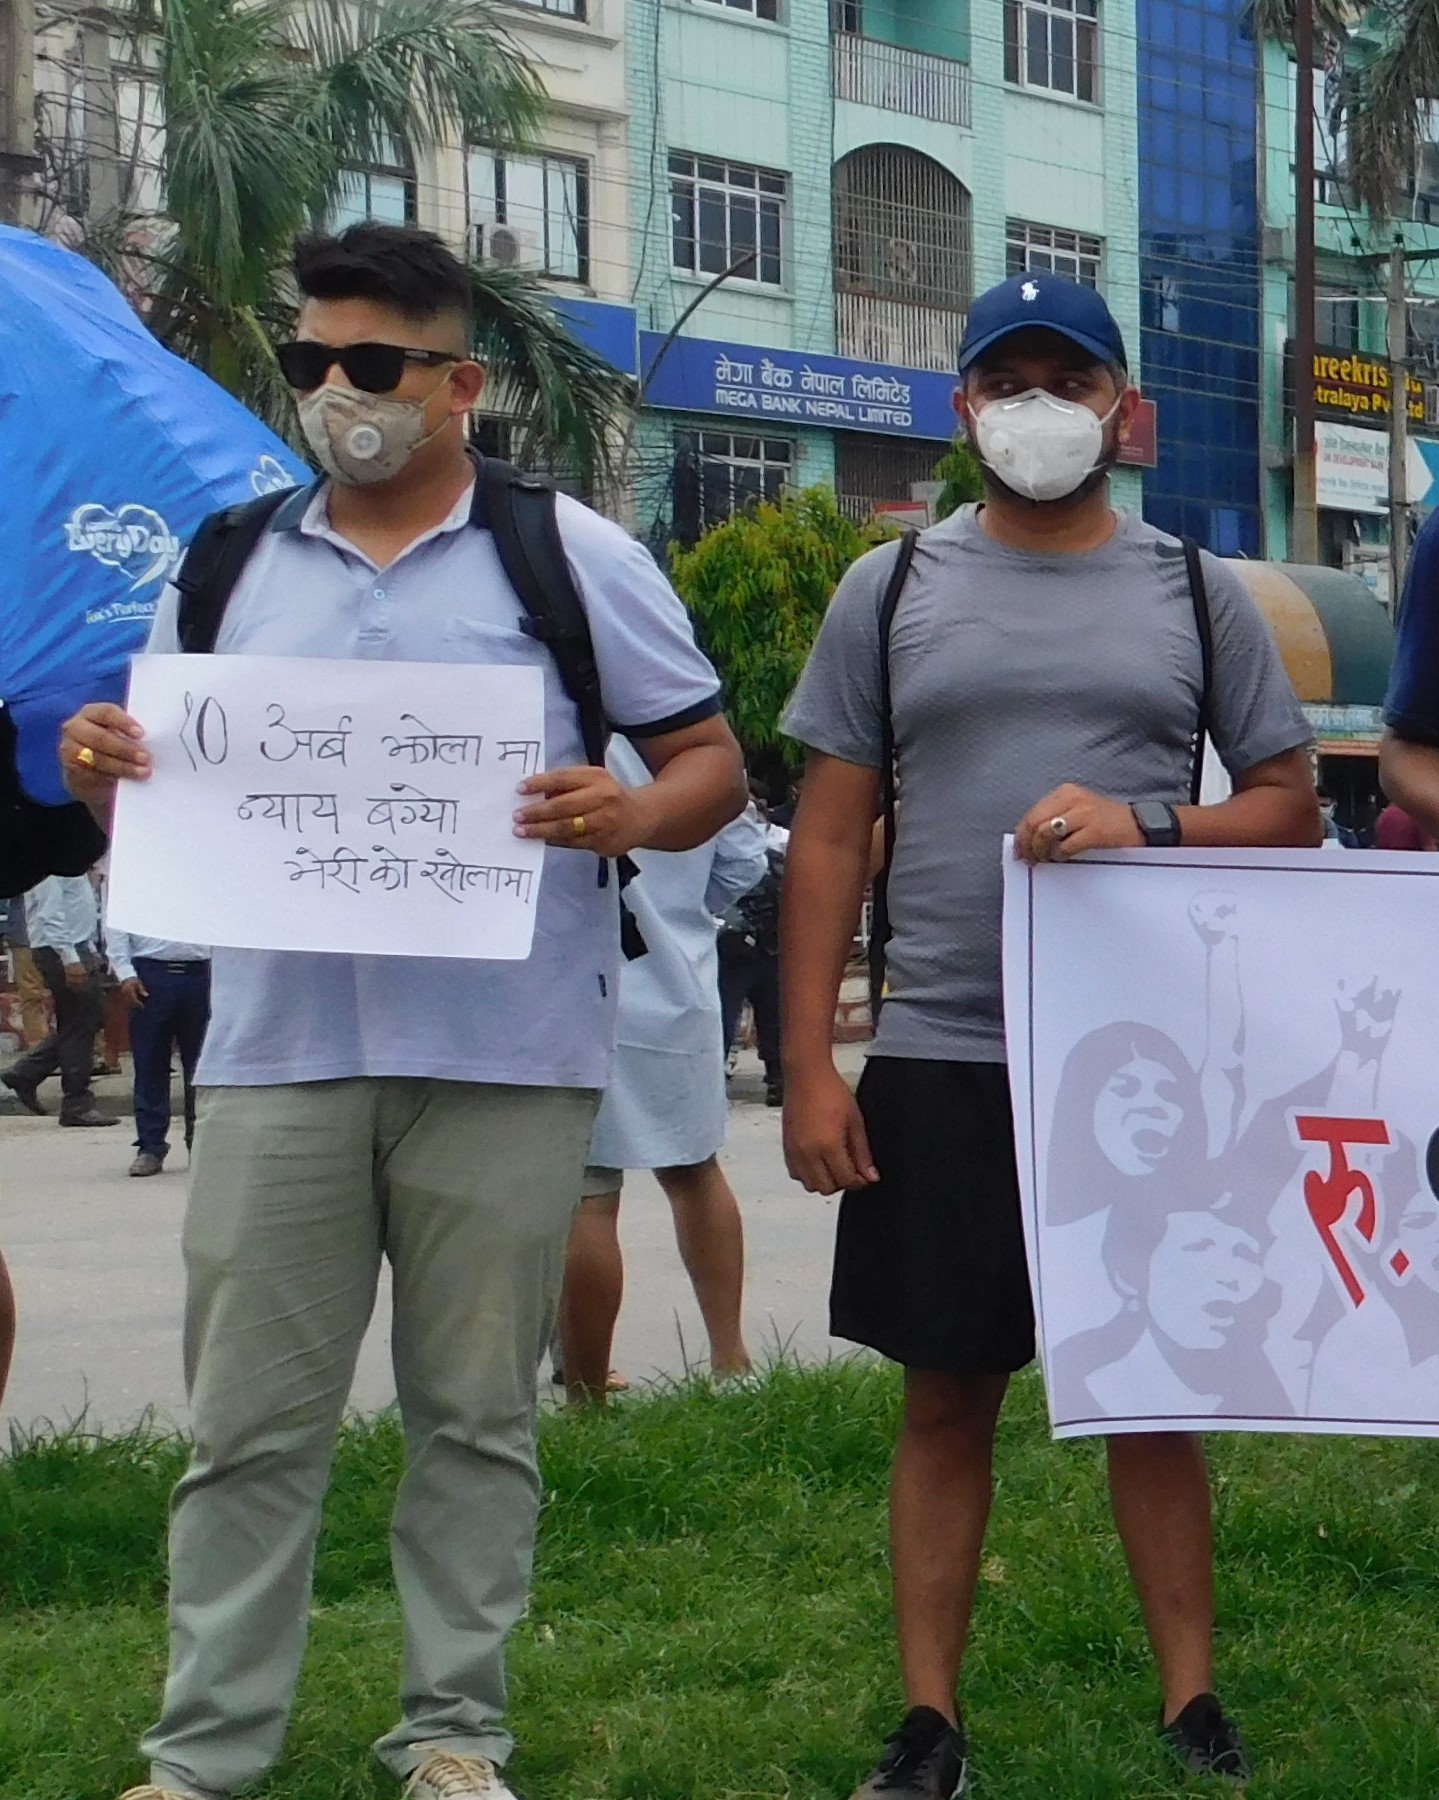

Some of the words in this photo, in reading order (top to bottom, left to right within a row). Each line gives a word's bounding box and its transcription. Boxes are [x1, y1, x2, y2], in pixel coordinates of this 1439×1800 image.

[715, 353, 752, 384] मेगा
[760, 358, 793, 389] बैंक
[800, 365, 845, 397] नेपाल
[851, 374, 911, 405] लिमिटेड
[1314, 385, 1369, 412] tralaya
[715, 388, 758, 408] MEGA
[762, 394, 802, 414] BANK
[805, 401, 854, 421] NEPAL
[858, 409, 912, 427] LIMITED
[260, 702, 353, 767] अर्ब
[381, 713, 483, 766] झोला
[496, 740, 541, 776] मा
[237, 793, 338, 834] न्याय
